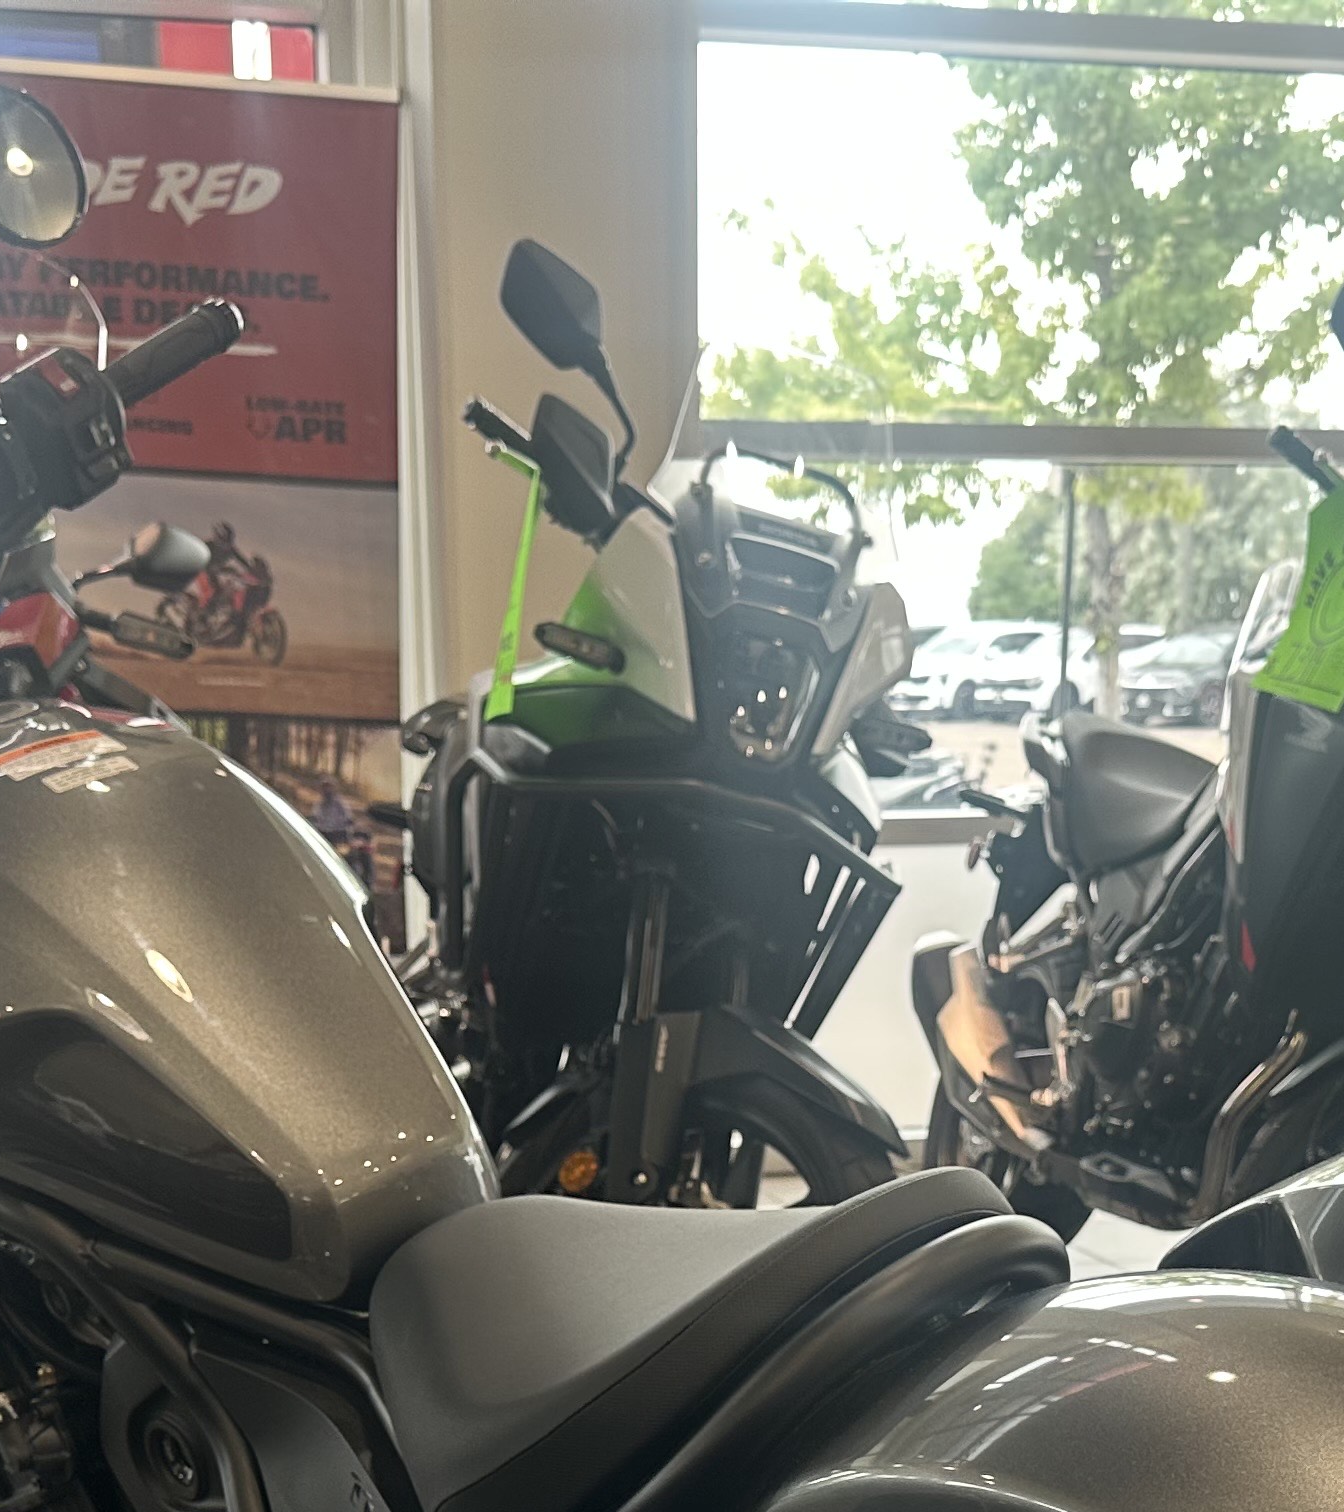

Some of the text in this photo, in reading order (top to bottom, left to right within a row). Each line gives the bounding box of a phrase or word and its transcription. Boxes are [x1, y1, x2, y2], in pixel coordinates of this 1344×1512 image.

[149, 158, 283, 227] RED
[39, 256, 331, 302] PERFORMANCE.
[275, 415, 347, 445] APR
